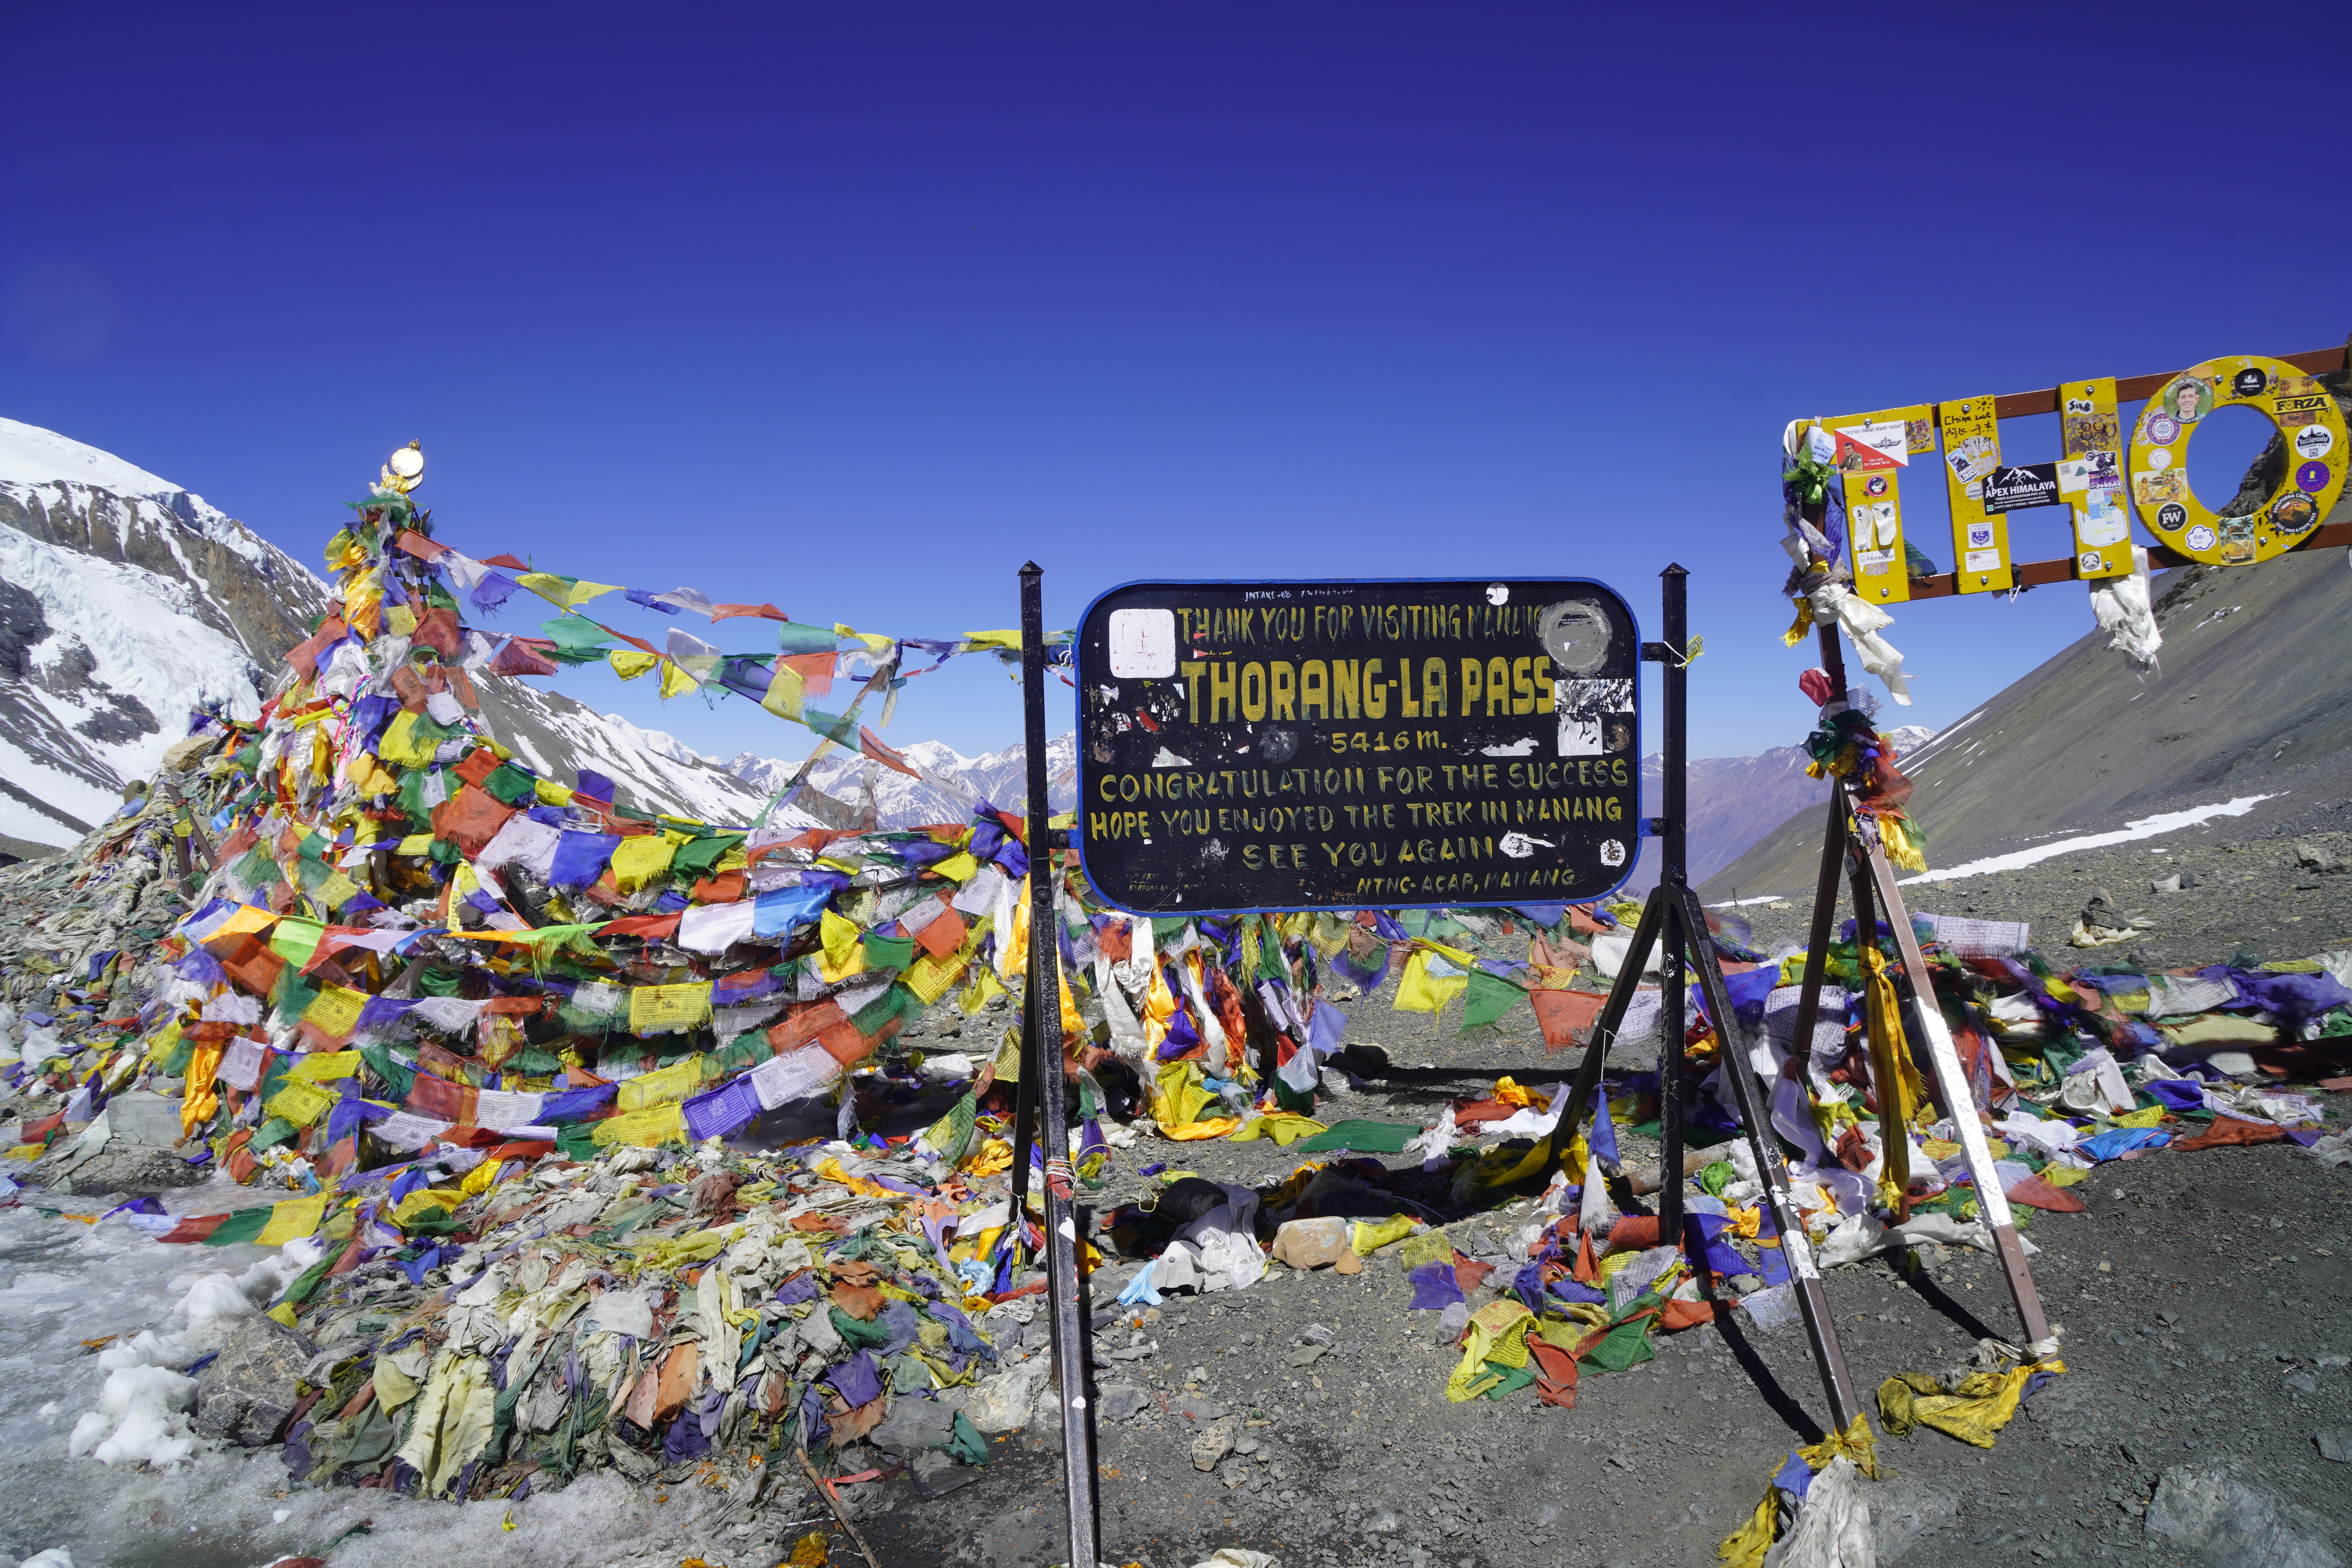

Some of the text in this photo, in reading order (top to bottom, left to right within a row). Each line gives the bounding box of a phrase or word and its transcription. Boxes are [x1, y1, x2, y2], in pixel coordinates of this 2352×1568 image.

[1945, 416, 1971, 425] China
[1959, 469, 1977, 482] LOUIS
[1985, 481, 2056, 498] APEX HIMALAYA
[2273, 494, 2313, 513] ANNAPURNA CIRCUIT
[2161, 511, 2182, 524] FW
[2275, 522, 2285, 530] 2025
[2299, 522, 2310, 531] PIOTR
[2308, 512, 2316, 523] TREK
[1245, 591, 1275, 601] INTAKE
[1177, 608, 1256, 645] THANK
[1261, 607, 1305, 642] YOU
[1315, 605, 1354, 642] FOR
[1361, 604, 1461, 641] VISITING
[1181, 656, 1555, 723] THORANG-LA PASS
[1331, 730, 1410, 753] 5416
[1100, 759, 1628, 802] CONGRATULATION FOR THE SUCCESS
[1091, 796, 1621, 841] HOPE YOU ENJOYED THE TREK IN MANANG
[1243, 836, 1493, 870] SEE YOU AGAIN
[1484, 868, 1575, 891] MANANG
